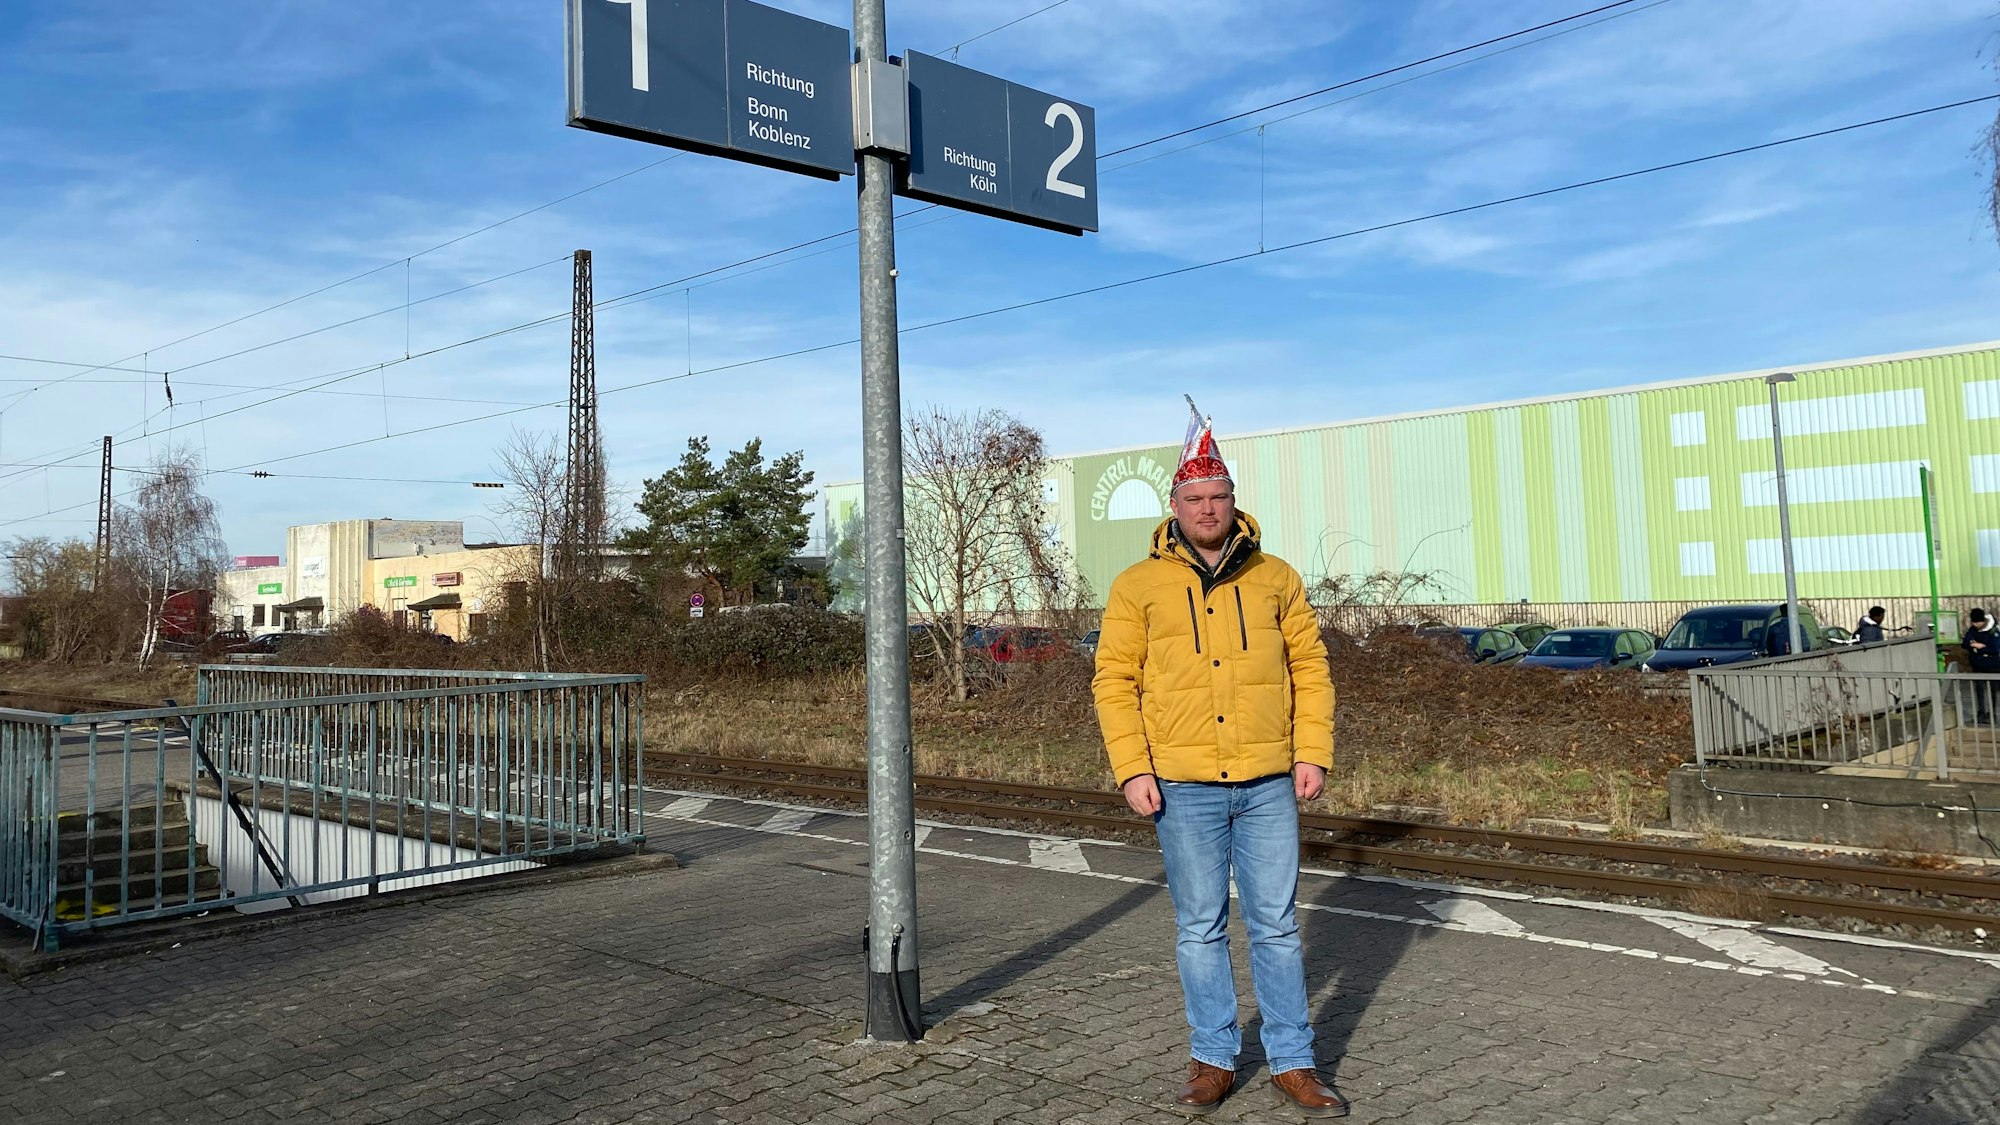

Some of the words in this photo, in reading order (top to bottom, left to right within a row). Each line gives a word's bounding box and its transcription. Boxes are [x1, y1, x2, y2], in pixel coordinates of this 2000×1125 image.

[606, 0, 649, 92] 1
[747, 62, 814, 99] Richtung
[748, 96, 788, 122] Bonn
[749, 120, 811, 150] Koblenz
[1044, 102, 1086, 199] 2
[944, 146, 996, 177] Richtung
[970, 174, 997, 194] Köln
[1091, 456, 1135, 521] CENTRAL
